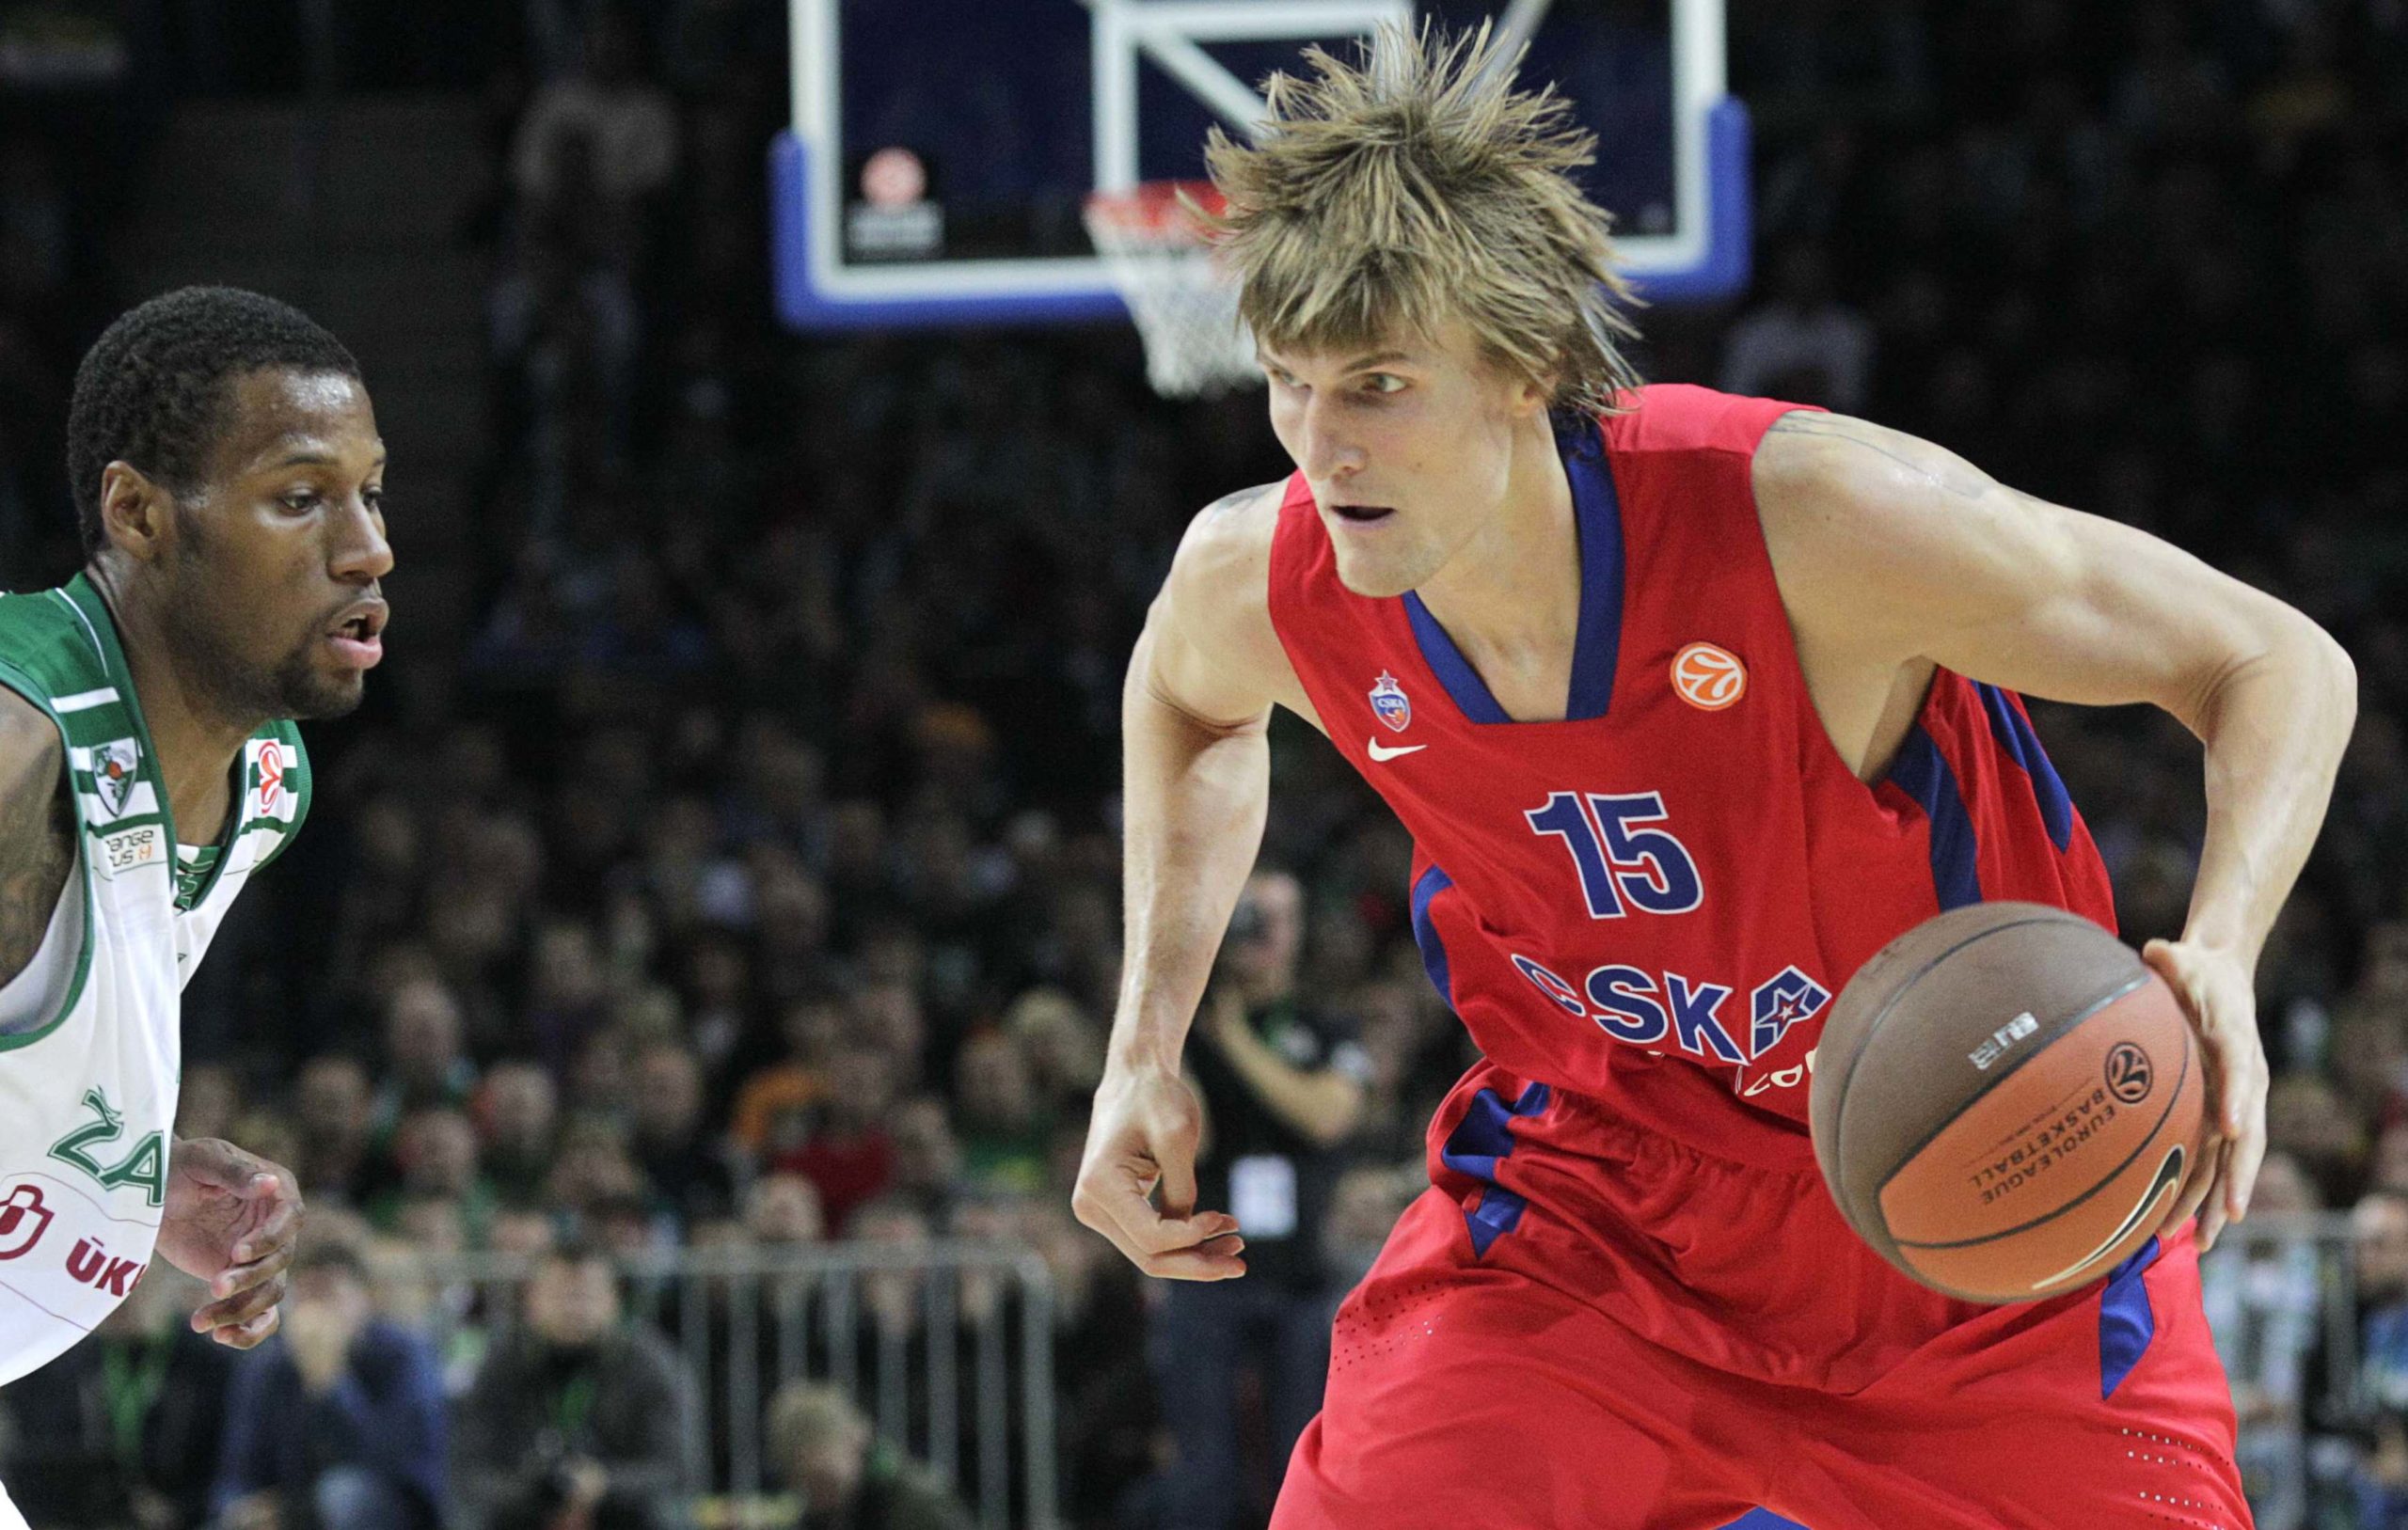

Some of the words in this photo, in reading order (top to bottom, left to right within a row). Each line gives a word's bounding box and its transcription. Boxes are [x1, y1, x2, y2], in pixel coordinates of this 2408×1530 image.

[1524, 791, 1703, 919] 15
[1511, 953, 1832, 1065] CSKA
[1971, 1089, 2106, 1187] BASKETBALL
[1981, 1105, 2115, 1205] EUROLEAGUE
